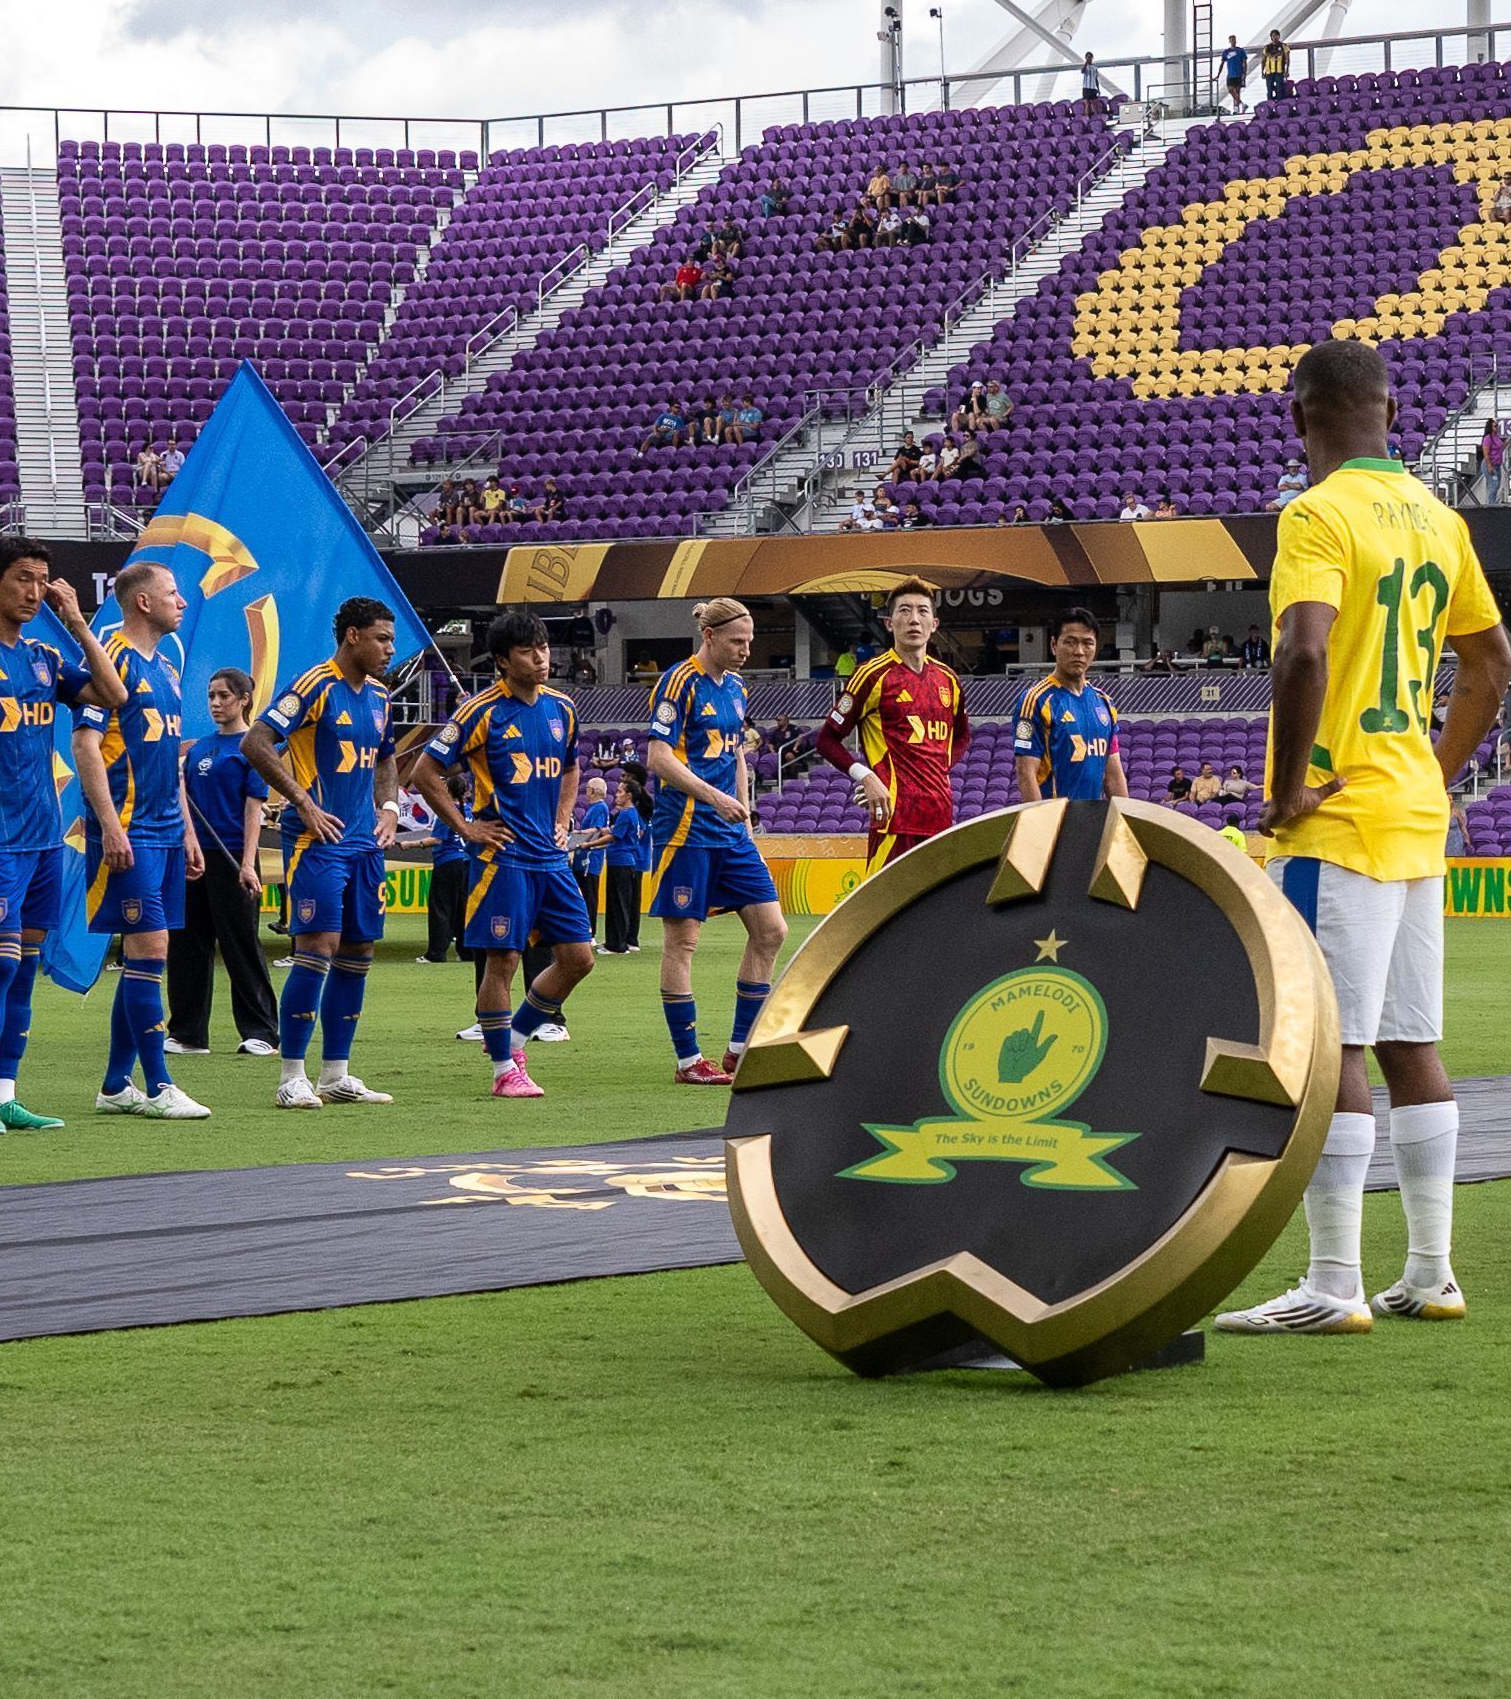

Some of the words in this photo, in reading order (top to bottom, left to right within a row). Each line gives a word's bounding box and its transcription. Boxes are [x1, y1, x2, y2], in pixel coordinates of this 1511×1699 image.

[854, 451, 878, 467] 131
[1359, 556, 1449, 736] 13
[23, 701, 54, 726] HD
[928, 720, 948, 741] HD
[1086, 736, 1108, 757] HD
[535, 756, 561, 778] HD
[990, 984, 1081, 1014] MAMELODI
[963, 1042, 975, 1051] 19
[1071, 1044, 1085, 1054] 70
[964, 1077, 1063, 1112] SUNDOWNS
[935, 1133, 958, 1144] The
[962, 1133, 985, 1146] Sky
[987, 1133, 997, 1144] is
[1002, 1133, 1023, 1146] the
[1026, 1136, 1059, 1149] Limit
